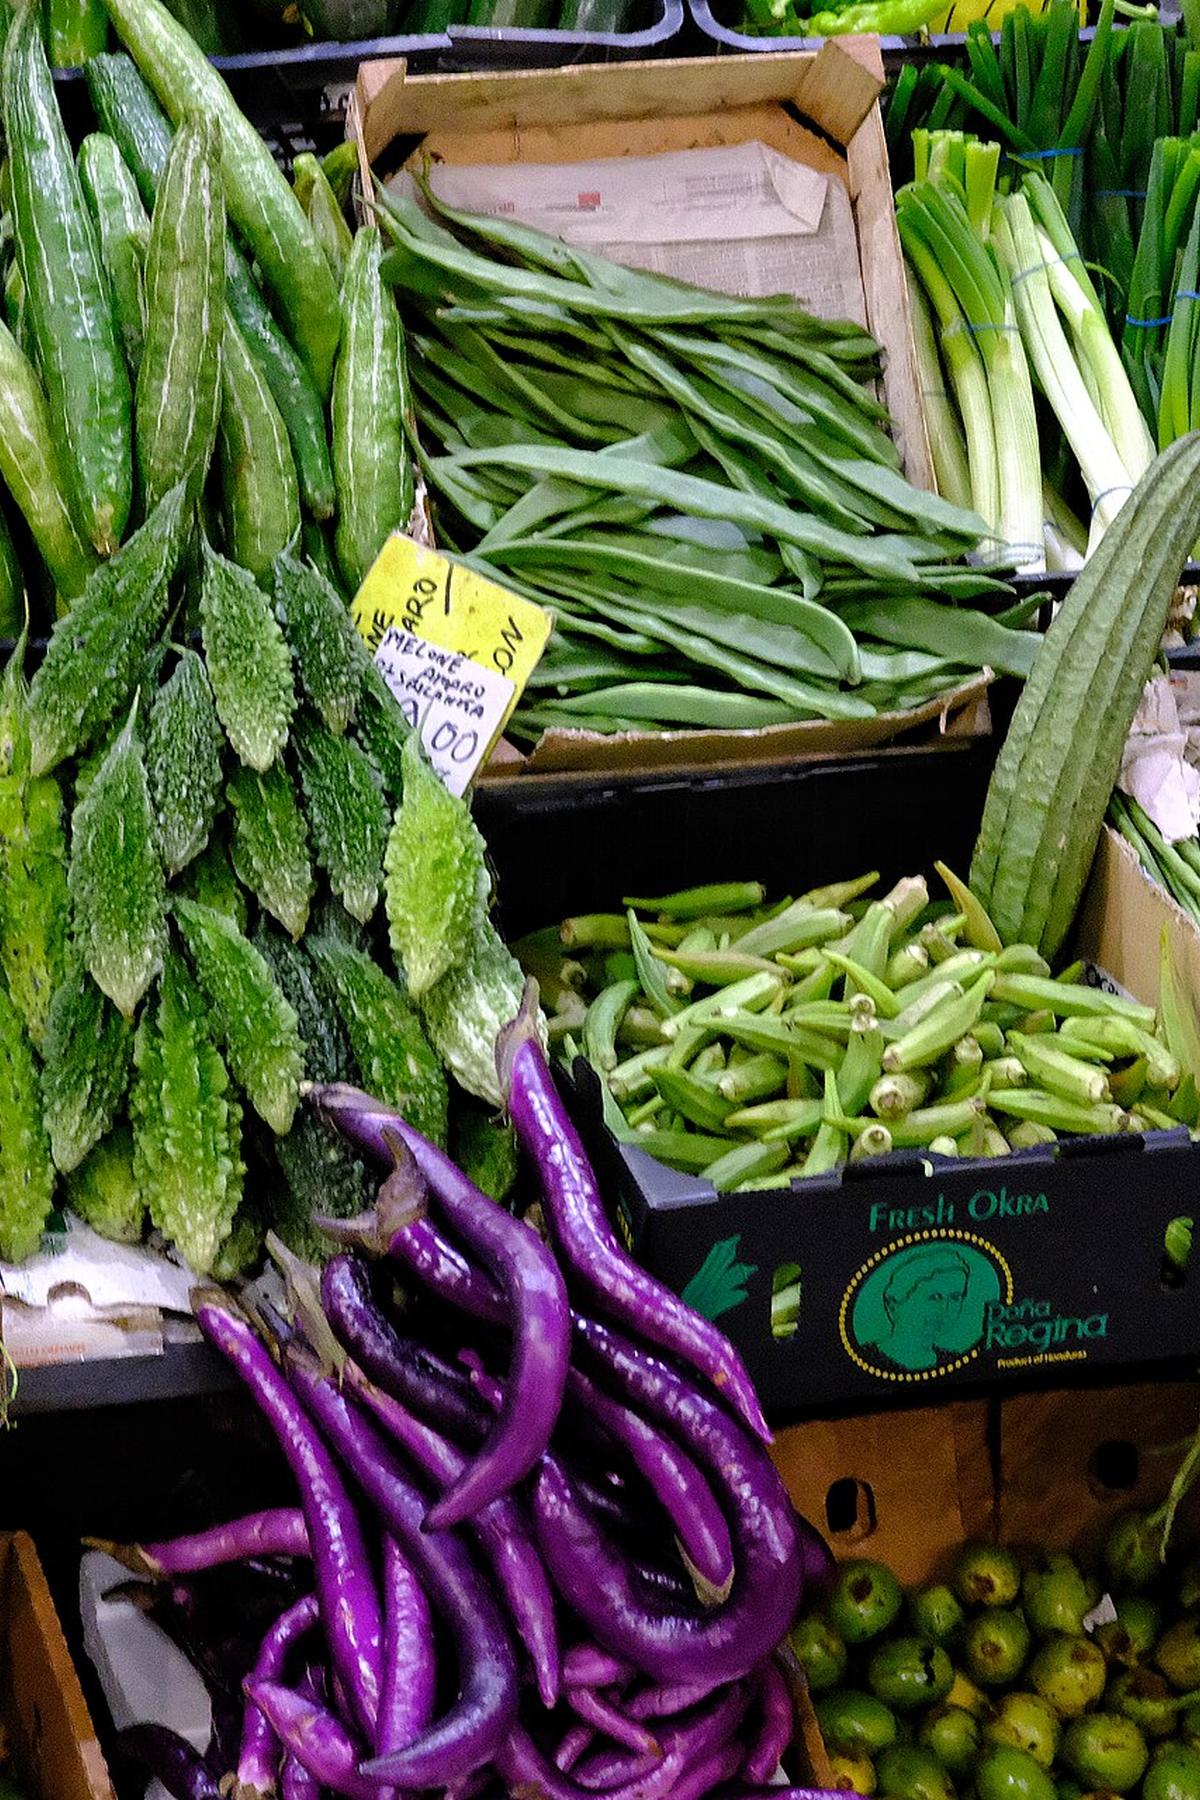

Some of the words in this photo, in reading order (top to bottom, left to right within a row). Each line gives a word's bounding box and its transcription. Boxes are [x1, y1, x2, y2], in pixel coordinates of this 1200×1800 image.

[383, 627, 465, 674] MELONE
[492, 615, 524, 676] ON
[984, 1314, 1109, 1353] Regina
